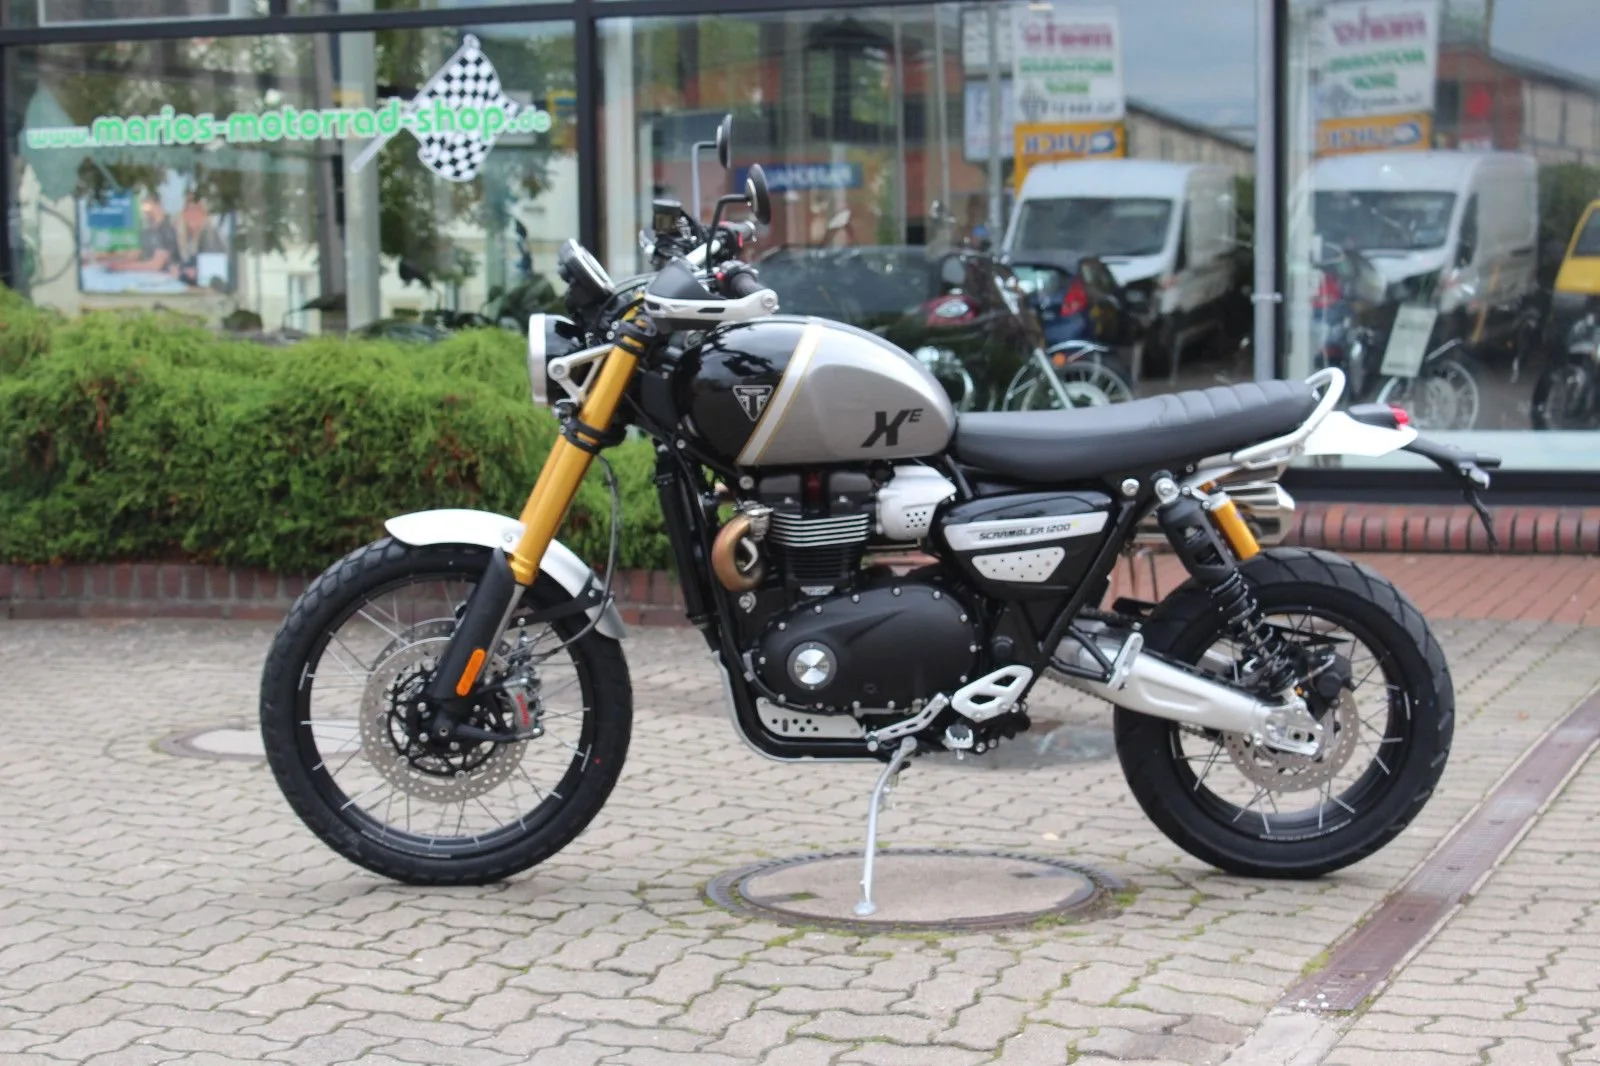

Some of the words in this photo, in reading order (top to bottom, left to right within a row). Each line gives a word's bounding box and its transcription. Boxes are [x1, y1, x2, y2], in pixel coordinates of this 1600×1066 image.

[27, 98, 551, 148] www.marios-motorrad-shop.de
[979, 525, 1044, 541] SCRAMBLER
[1046, 522, 1071, 534] 1200
